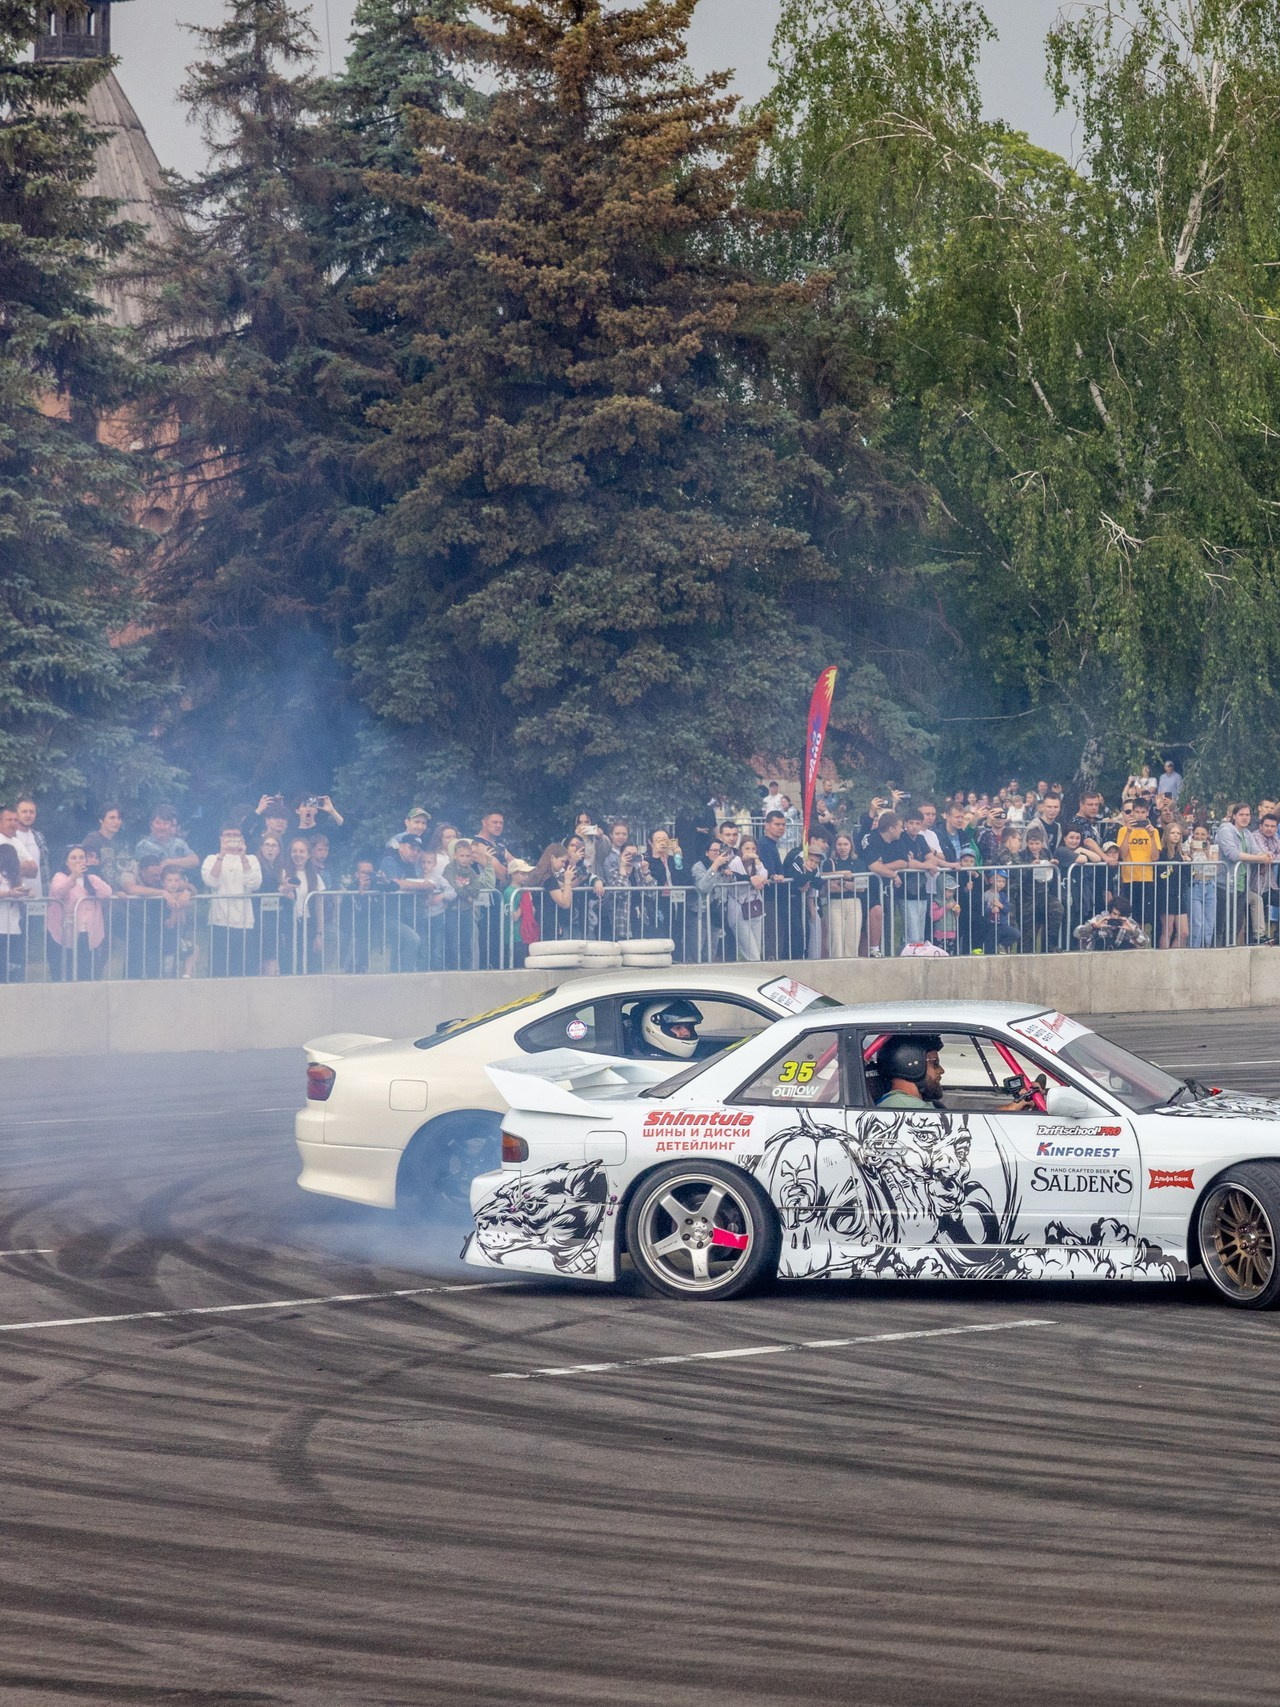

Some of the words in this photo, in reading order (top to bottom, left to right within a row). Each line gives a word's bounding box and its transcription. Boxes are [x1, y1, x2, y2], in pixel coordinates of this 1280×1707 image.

[778, 1060, 817, 1083] 35
[643, 1111, 754, 1126] Shinntula
[642, 1128, 686, 1137] ШИНЫ
[690, 1128, 699, 1137] И
[703, 1128, 751, 1138] ДИСКИ
[655, 1139, 736, 1152] ДЕТЕЙЛИНГ
[1036, 1142, 1120, 1157] KINFOREST
[1030, 1166, 1133, 1194] SALDEN'S
[1154, 1175, 1173, 1183] Альфа
